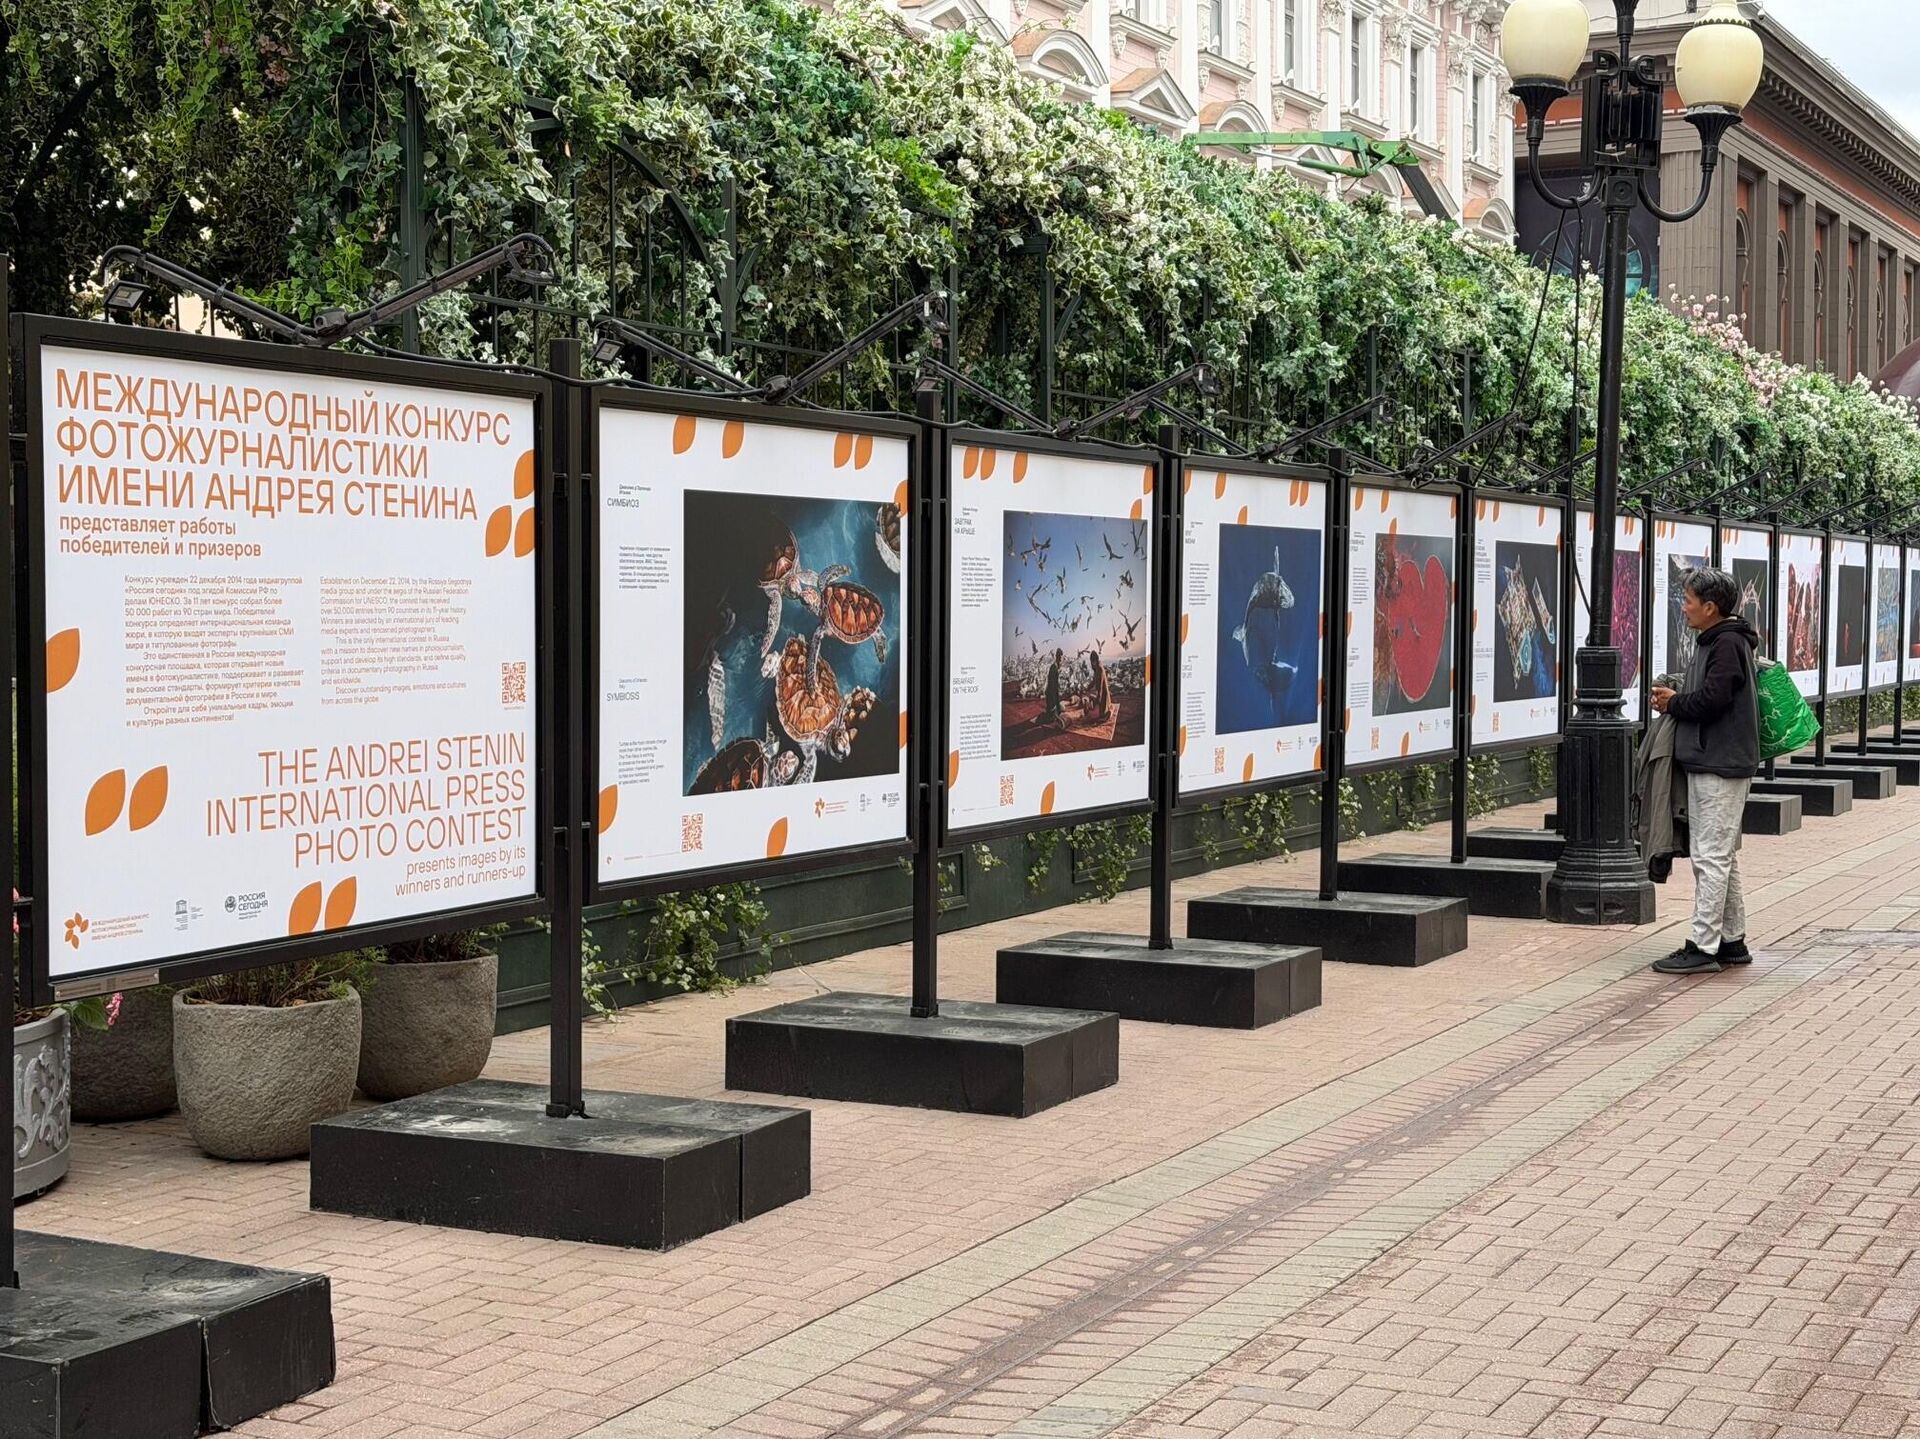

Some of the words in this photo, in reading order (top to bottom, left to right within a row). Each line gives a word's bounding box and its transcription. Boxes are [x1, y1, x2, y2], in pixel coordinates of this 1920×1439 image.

[56, 368, 379, 436] МЕЖДУНАРОДНЫЙ
[386, 402, 510, 445] КОНКУРС
[57, 416, 427, 479] ФОТОЖУРНАЛИСТИКИ
[59, 464, 193, 508] ИМЕНИ
[204, 473, 333, 519] АНДРЕЯ
[344, 481, 477, 520] СТЕНИНА
[607, 497, 640, 508] СИМБИОЗ
[60, 516, 175, 538] представляет
[180, 517, 236, 538] работы
[60, 533, 169, 556] победителей
[175, 542, 183, 555] и
[189, 543, 261, 561] призеров
[125, 575, 154, 584] Конкурс
[199, 576, 226, 584] декабря
[201, 586, 224, 595] эгидой
[212, 598, 238, 606] конкурс
[239, 597, 263, 605] собрал
[125, 608, 135, 616] 50
[136, 608, 151, 616] 000
[152, 608, 172, 617] работ
[125, 620, 158, 628] конкурса
[159, 620, 198, 628] определяет
[265, 618, 291, 626] команда
[154, 631, 183, 639] которую
[207, 630, 238, 638] эксперты
[125, 643, 144, 651] мира
[126, 664, 166, 673] конкурсная
[204, 662, 230, 670] которая
[231, 691, 254, 699] России
[144, 706, 176, 716] Откройте
[178, 706, 190, 714] для
[191, 704, 207, 712] себя
[132, 718, 165, 728] культуры
[258, 748, 317, 787] THE
[325, 739, 427, 781] ANDREI
[437, 732, 524, 771] STENIN
[208, 778, 441, 836] INTERNATIONAL
[447, 769, 524, 809] PRESS
[296, 823, 397, 868] PHOTO
[406, 806, 526, 852] CONTEST
[407, 856, 455, 879] presents
[459, 851, 496, 871] images
[499, 848, 512, 864] by
[514, 845, 525, 859] its
[395, 878, 440, 896] winners
[444, 870, 464, 888] and
[468, 865, 525, 884] runners-up
[239, 892, 265, 902] РОССИЯ
[238, 900, 268, 911] СЕГОДНЯ
